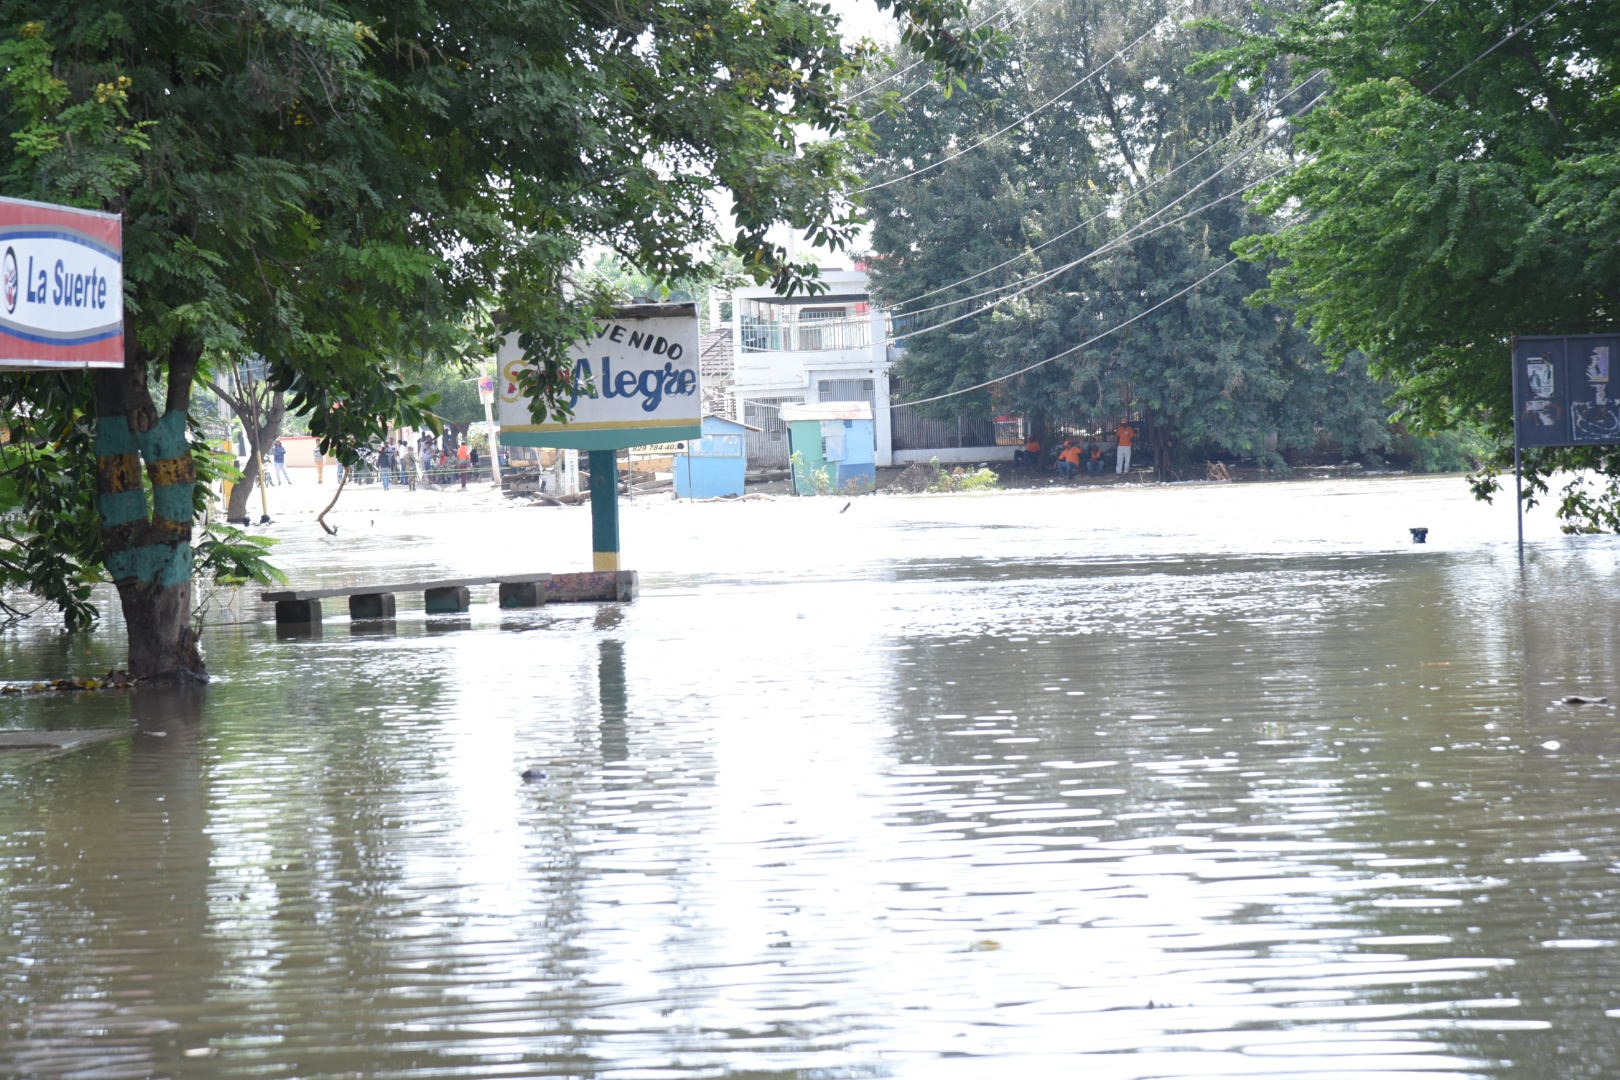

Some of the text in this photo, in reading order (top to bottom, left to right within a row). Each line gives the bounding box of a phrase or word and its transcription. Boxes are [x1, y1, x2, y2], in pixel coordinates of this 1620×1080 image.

[27, 255, 107, 309] La Suerte
[595, 322, 684, 361] VENIDO
[568, 355, 697, 412] Alegre
